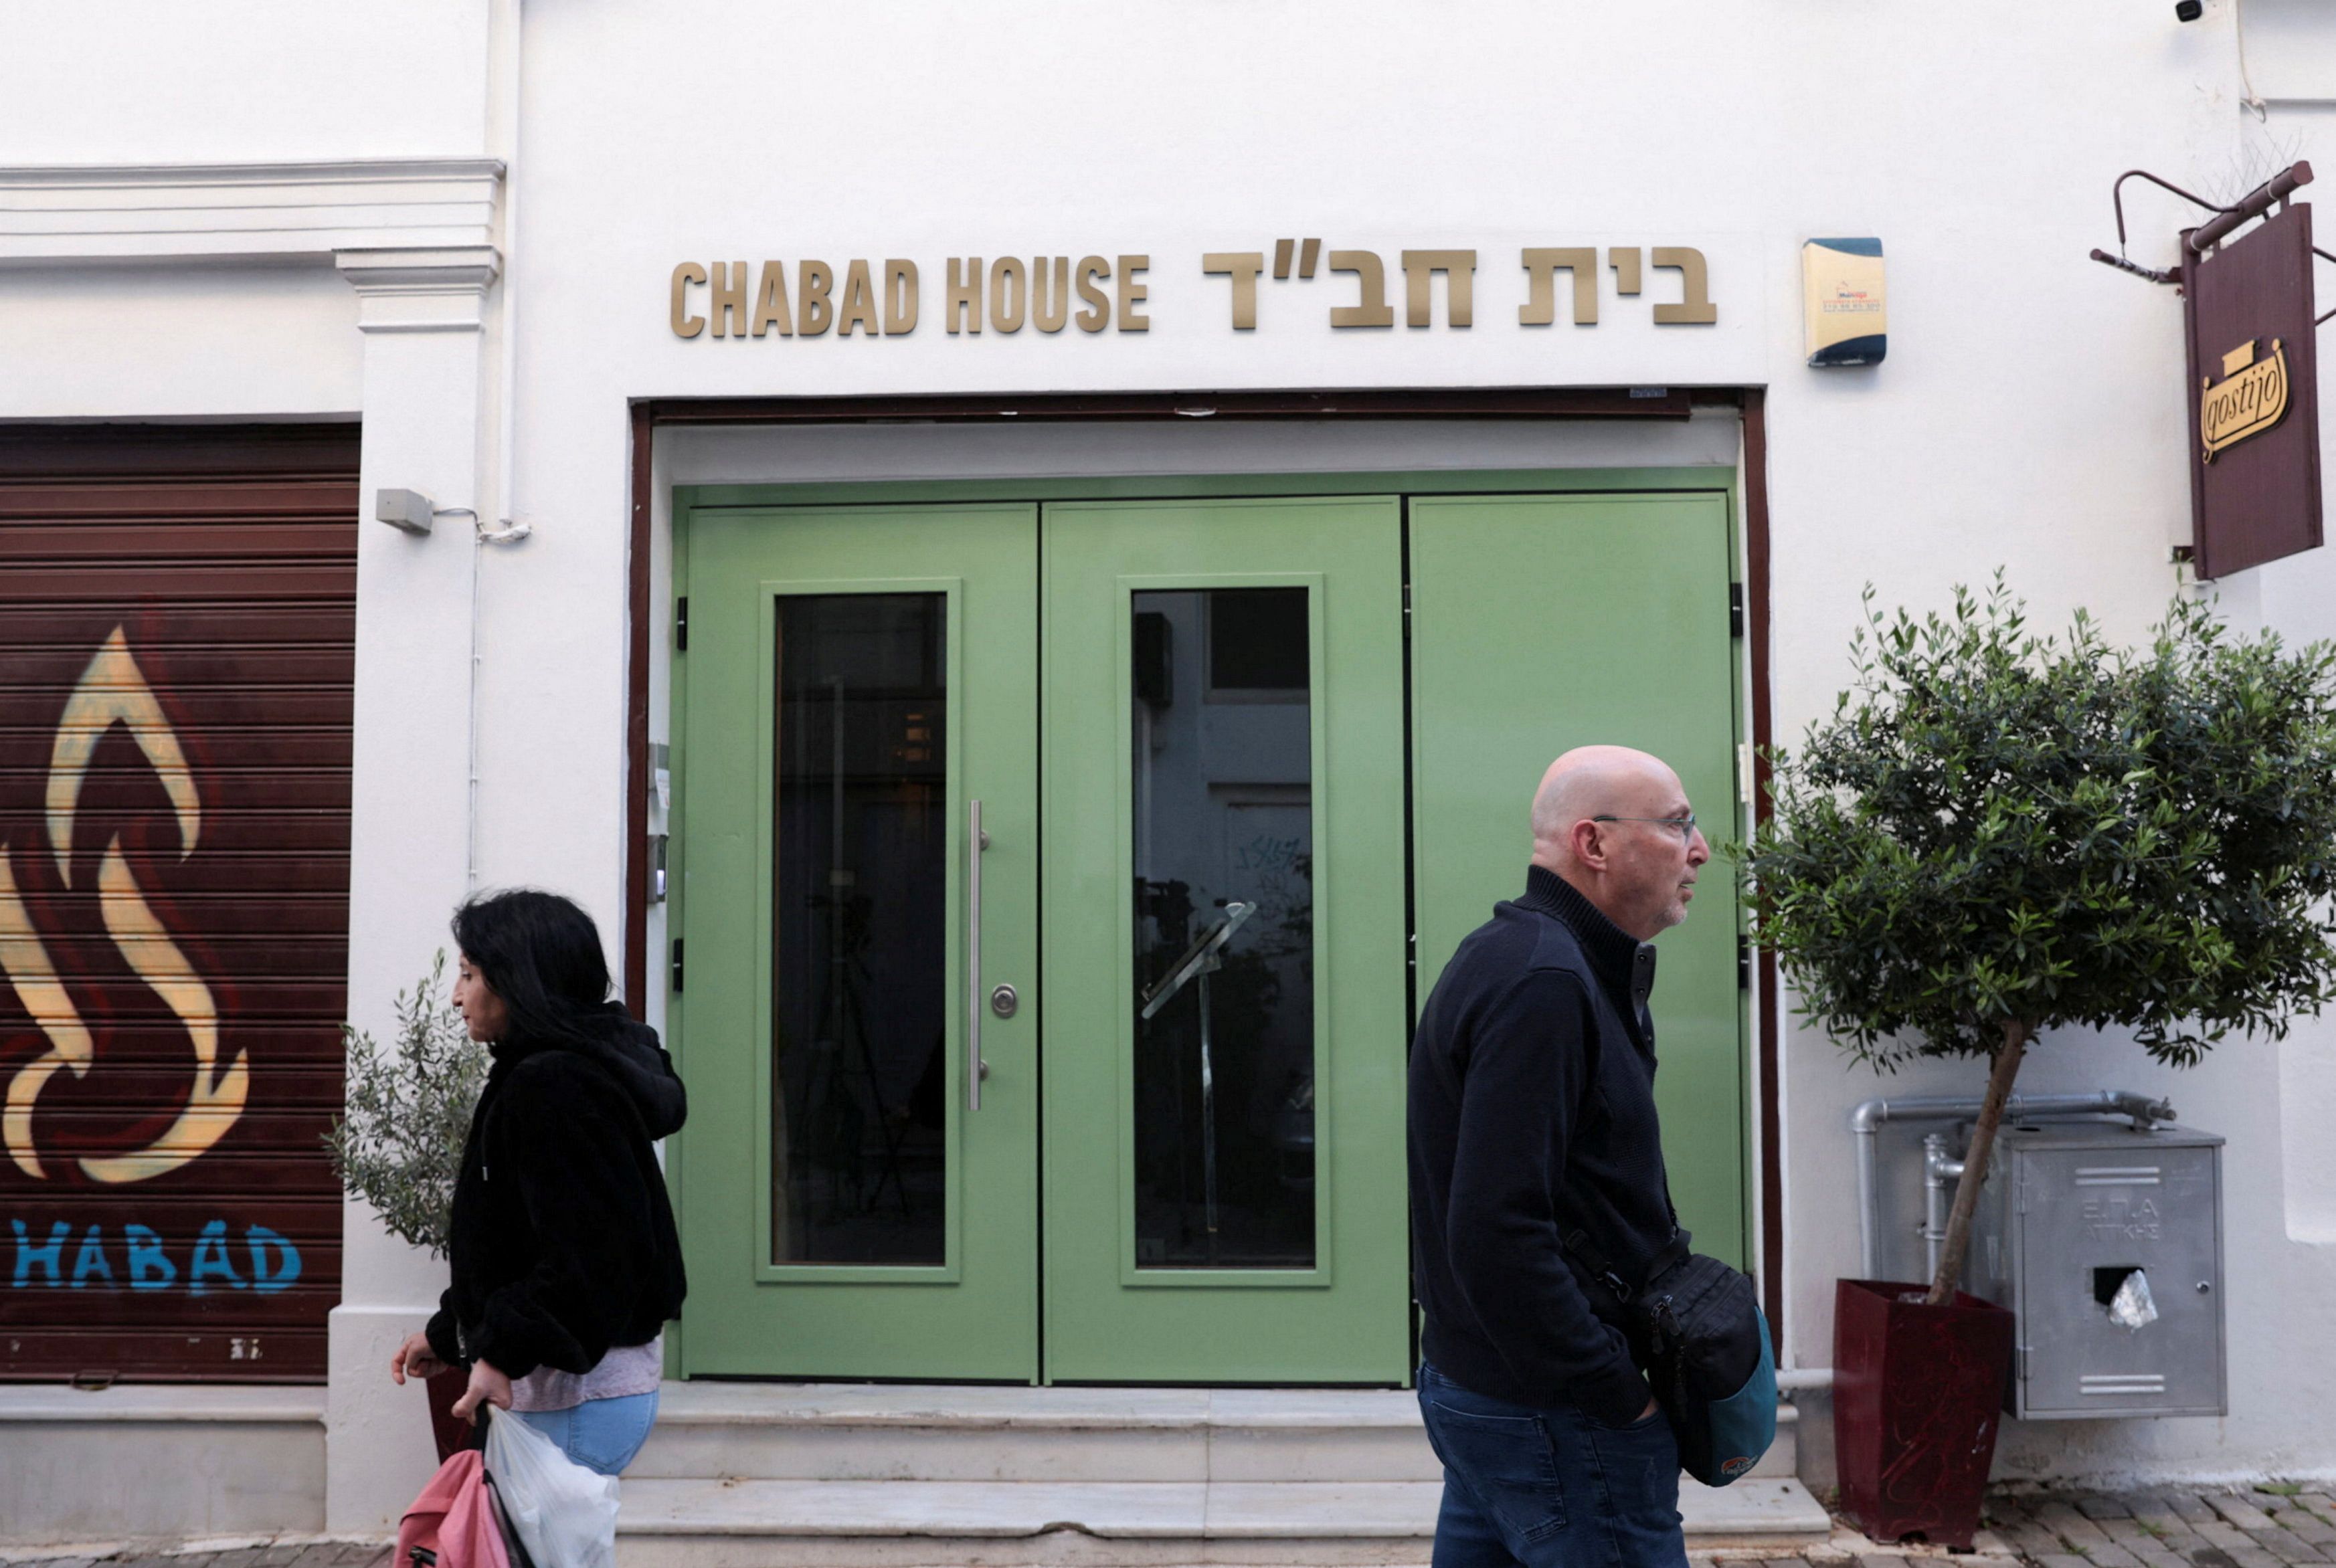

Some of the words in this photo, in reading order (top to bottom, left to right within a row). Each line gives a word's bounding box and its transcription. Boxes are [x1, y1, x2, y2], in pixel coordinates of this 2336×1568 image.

[670, 259, 919, 338] CHABAD
[946, 256, 1150, 333] HOUSE
[1520, 248, 1717, 324] בית
[2203, 366, 2277, 464] gostijo
[11, 1216, 303, 1296] HABAD
